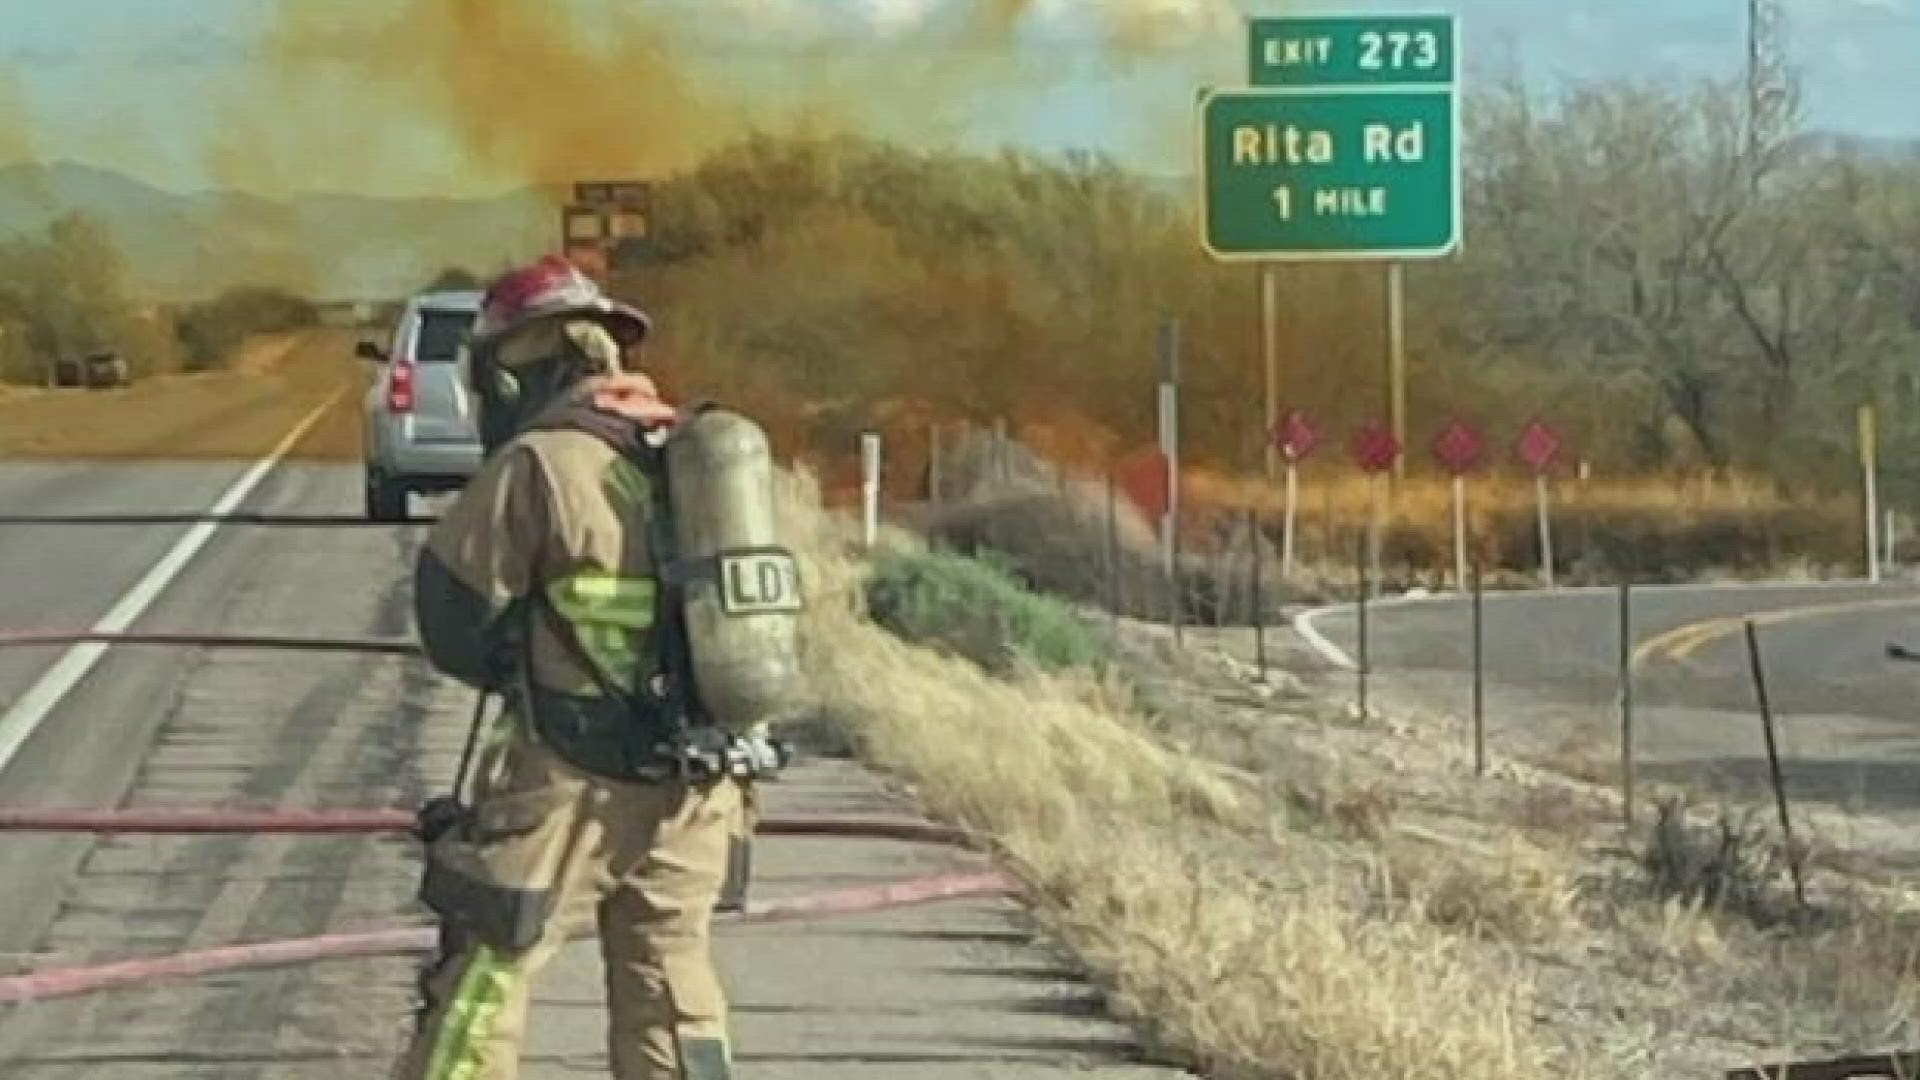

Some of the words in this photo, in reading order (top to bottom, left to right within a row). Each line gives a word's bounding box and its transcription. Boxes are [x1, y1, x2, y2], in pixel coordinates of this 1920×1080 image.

[1263, 37, 1331, 66] EXIT
[1358, 31, 1438, 70] 273
[1232, 123, 1334, 165] Rita
[1362, 120, 1424, 163] Rd
[1273, 184, 1291, 222] 1
[1313, 186, 1387, 216] MILE
